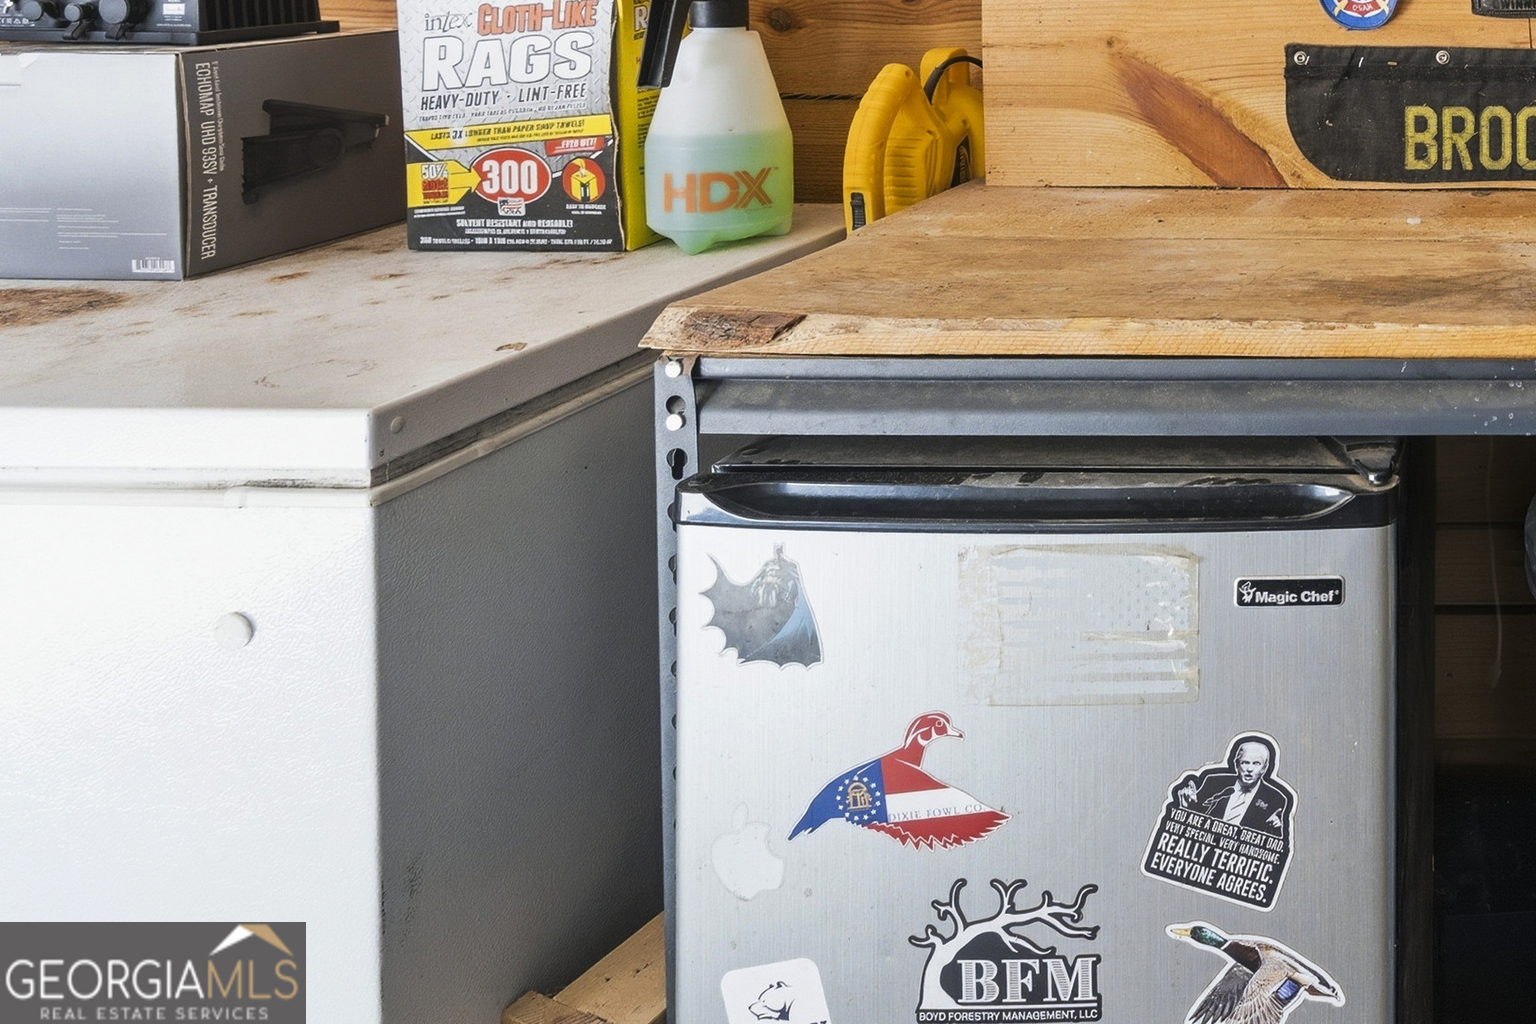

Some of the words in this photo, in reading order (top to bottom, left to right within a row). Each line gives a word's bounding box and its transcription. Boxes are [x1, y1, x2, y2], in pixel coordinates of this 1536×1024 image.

[422, 30, 594, 92] RAGS
[195, 61, 215, 116] ECHOMAP
[420, 89, 500, 111] HEAVY-DUTY
[518, 82, 587, 103] LINT-FREE
[200, 120, 217, 145] UHD
[452, 129, 463, 140] 3X
[493, 126, 511, 135] THAN
[512, 124, 535, 133] PAPER
[201, 146, 218, 175] 93SV
[481, 159, 538, 195] 300
[663, 166, 773, 214] HDX
[201, 184, 218, 260] TRANSDUCER
[1255, 590, 1298, 605] Magic
[1300, 590, 1335, 603] Chef
[888, 810, 922, 822] DIXIE
[926, 806, 960, 818] FOWL
[1170, 807, 1187, 822] YOU
[1187, 813, 1203, 828] ARE
[1204, 820, 1211, 829] A
[1240, 829, 1266, 846] GREAT
[1266, 837, 1285, 853] DAD.
[1165, 820, 1184, 835] VERY
[1219, 836, 1238, 851] VERY
[1157, 832, 1211, 864] REALLY
[1213, 848, 1274, 885] TERRIFIC.
[1150, 852, 1217, 887] EVERYONE
[1216, 873, 1268, 904] AGREES.
[957, 957, 1098, 1003] BFM
[919, 1012, 947, 1021] BOYD
[949, 1011, 1000, 1021] FORESTRY
[1002, 1010, 1077, 1021] MANAGEMENT,
[1079, 1009, 1098, 1019] LLC
